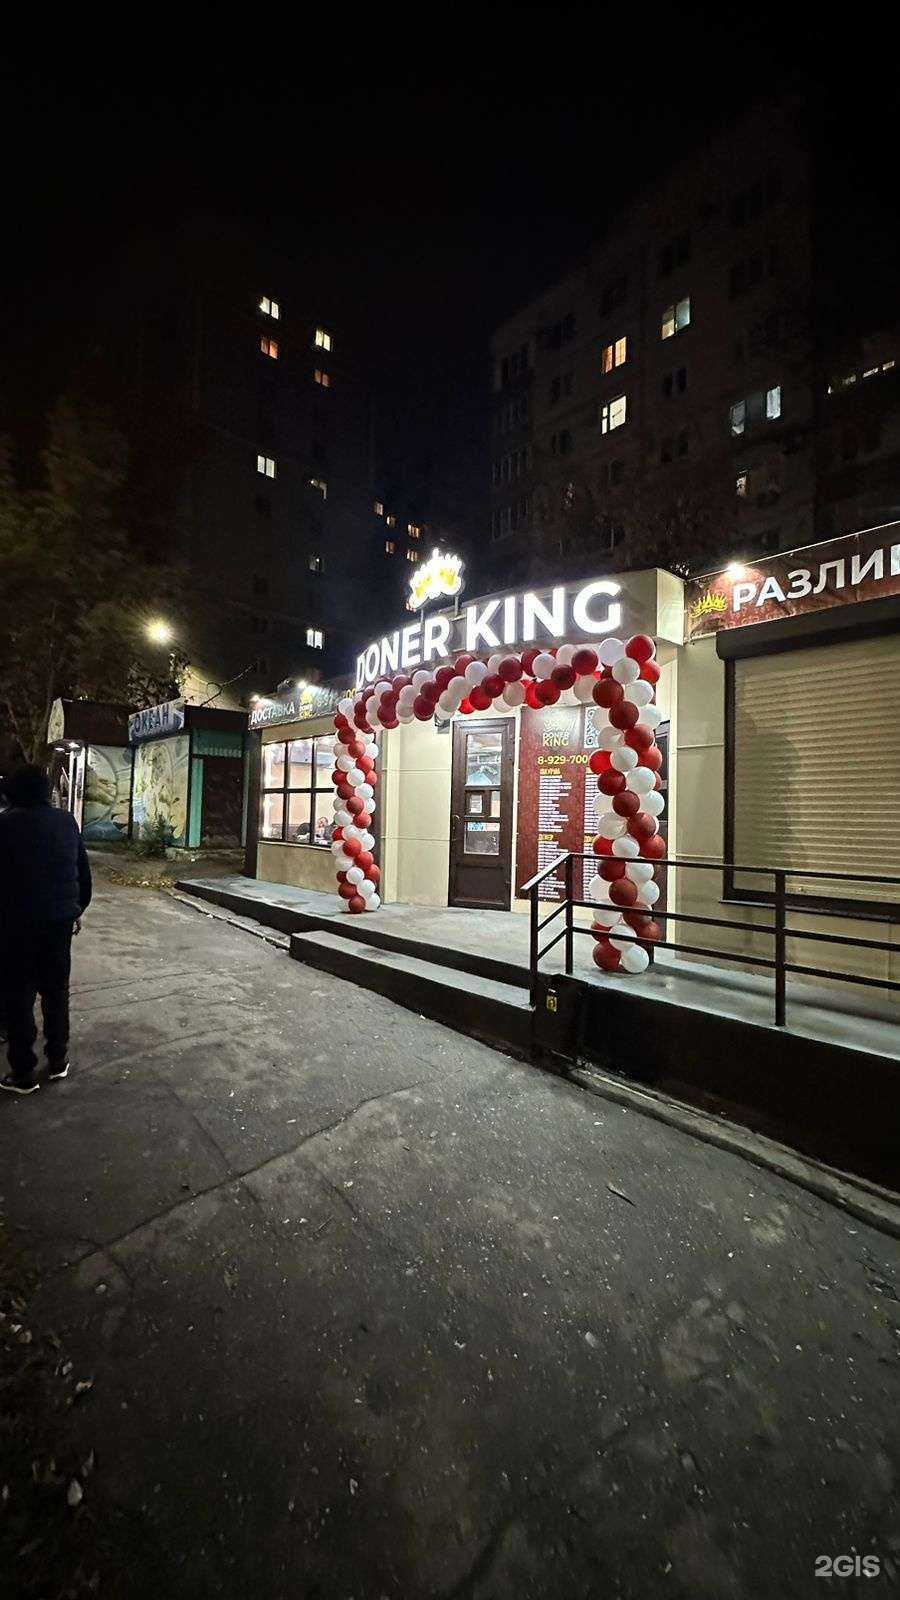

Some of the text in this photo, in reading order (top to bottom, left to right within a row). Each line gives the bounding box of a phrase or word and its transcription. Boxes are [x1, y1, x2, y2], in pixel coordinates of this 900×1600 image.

[356, 580, 622, 691] DONER KING
[249, 700, 296, 725] ДОСТАВКА
